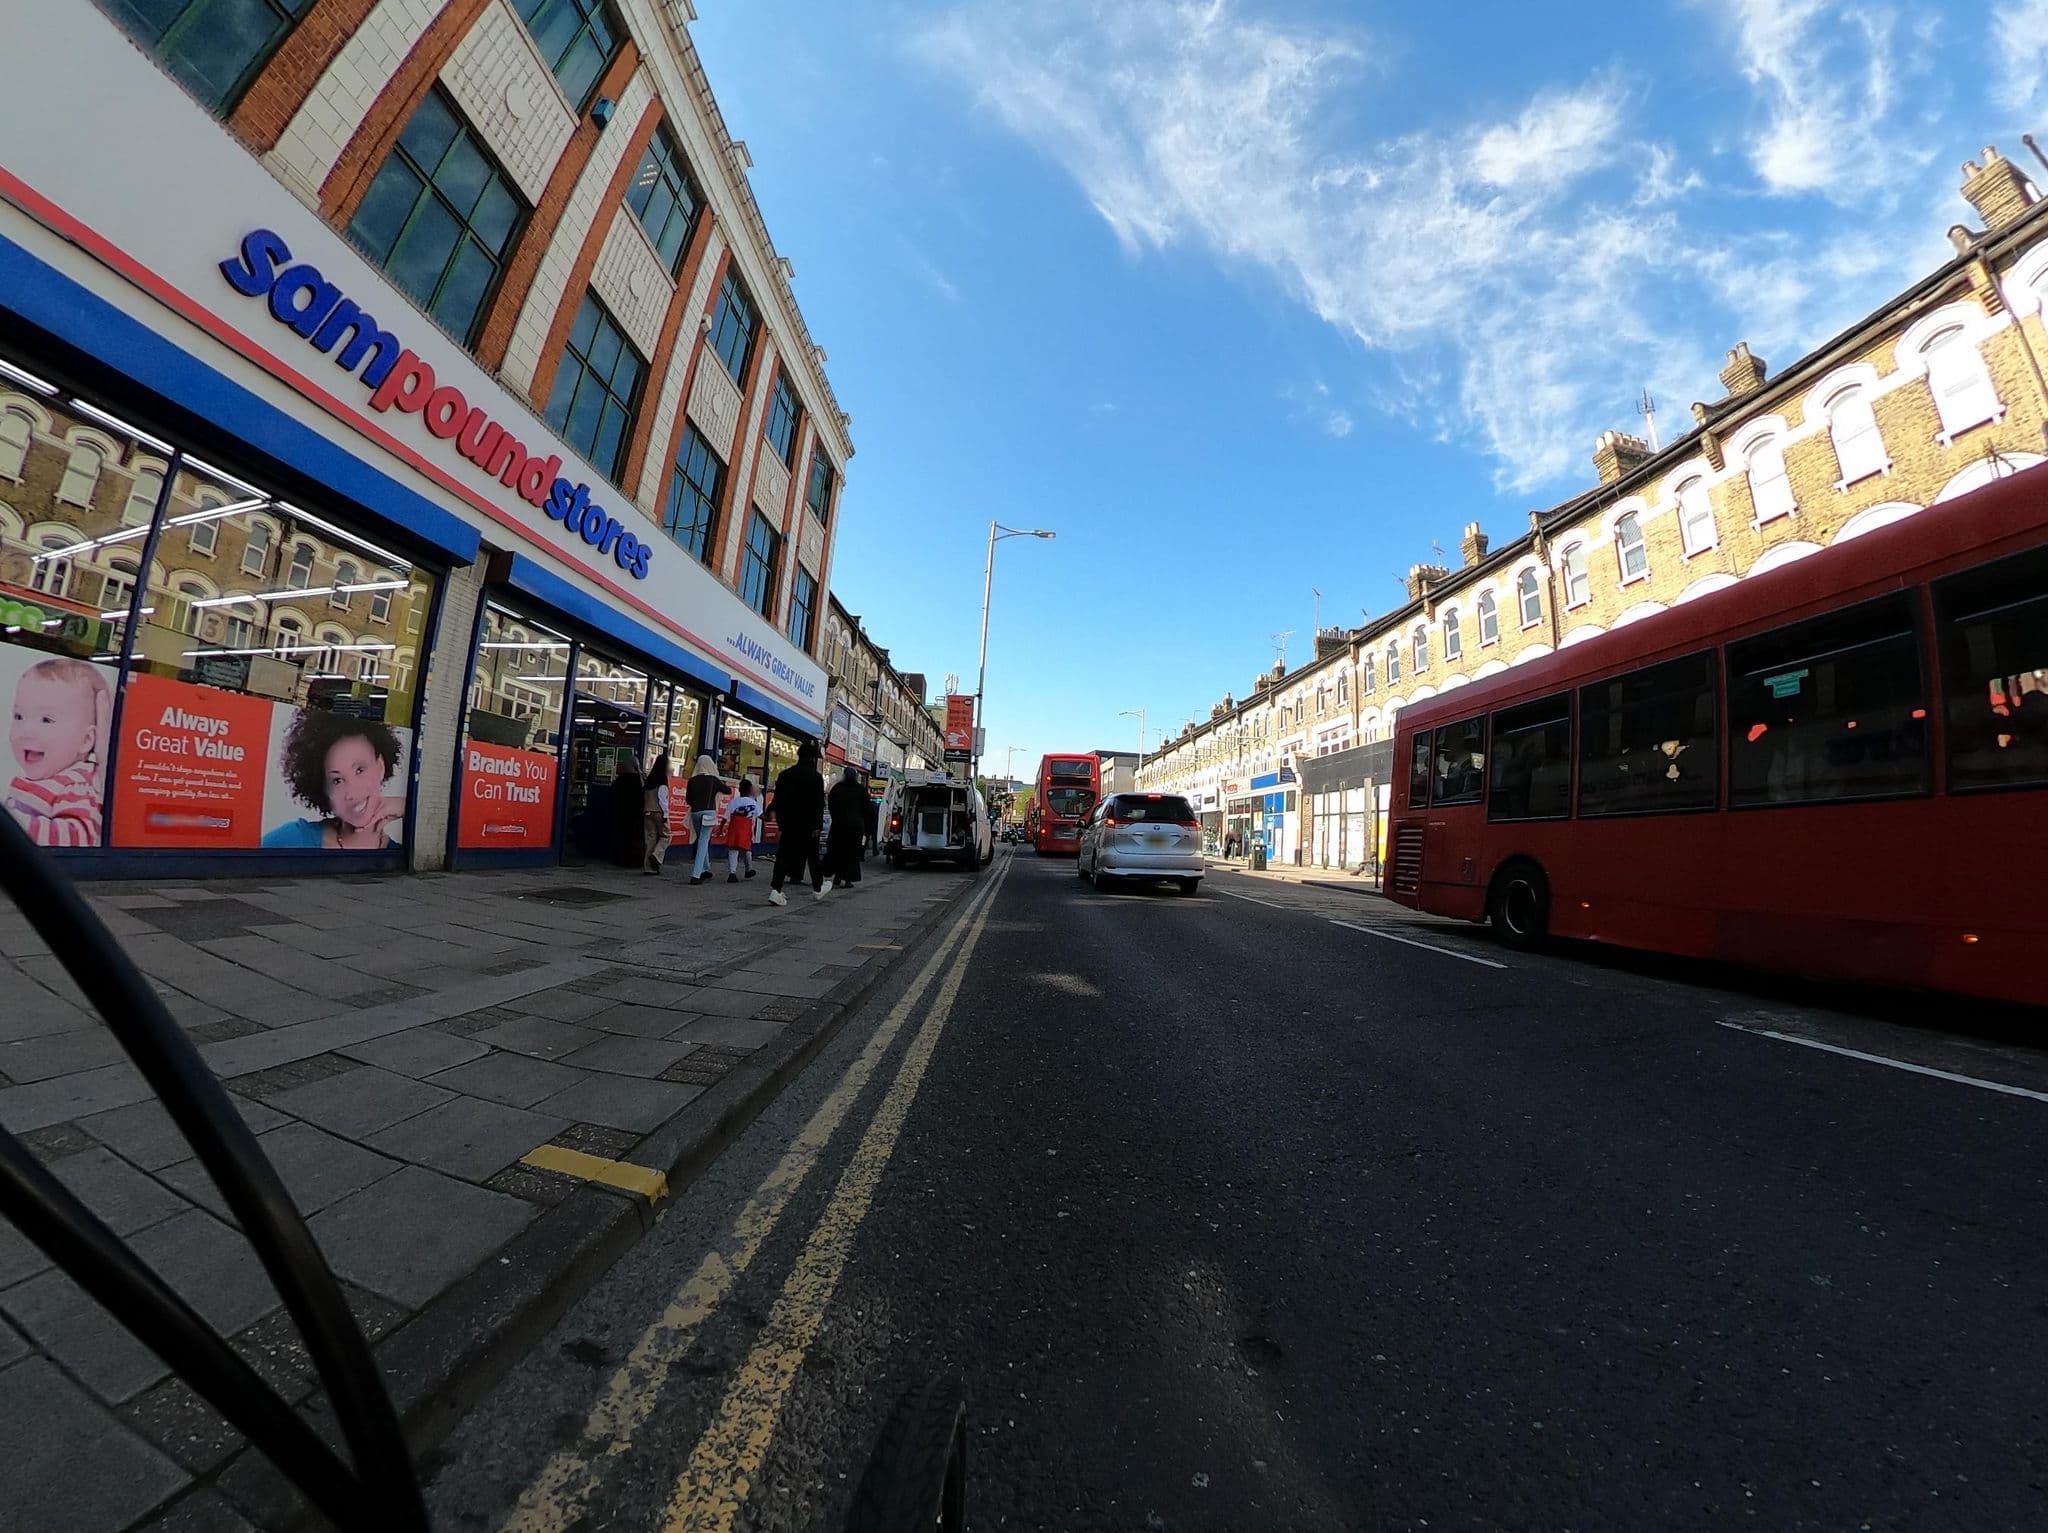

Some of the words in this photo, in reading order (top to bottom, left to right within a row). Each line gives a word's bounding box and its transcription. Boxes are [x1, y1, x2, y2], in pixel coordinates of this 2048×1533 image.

[219, 228, 653, 580] sampoundstores
[727, 632, 772, 670] ...ALWAYS
[771, 657, 795, 685] GREAT
[794, 673, 816, 699] VALUE
[160, 706, 229, 737] Always
[136, 728, 189, 755] Great
[193, 736, 245, 762] Value
[469, 750, 521, 778] Brands
[525, 760, 548, 781] You
[474, 778, 502, 800] Can
[506, 782, 541, 804] Trust
